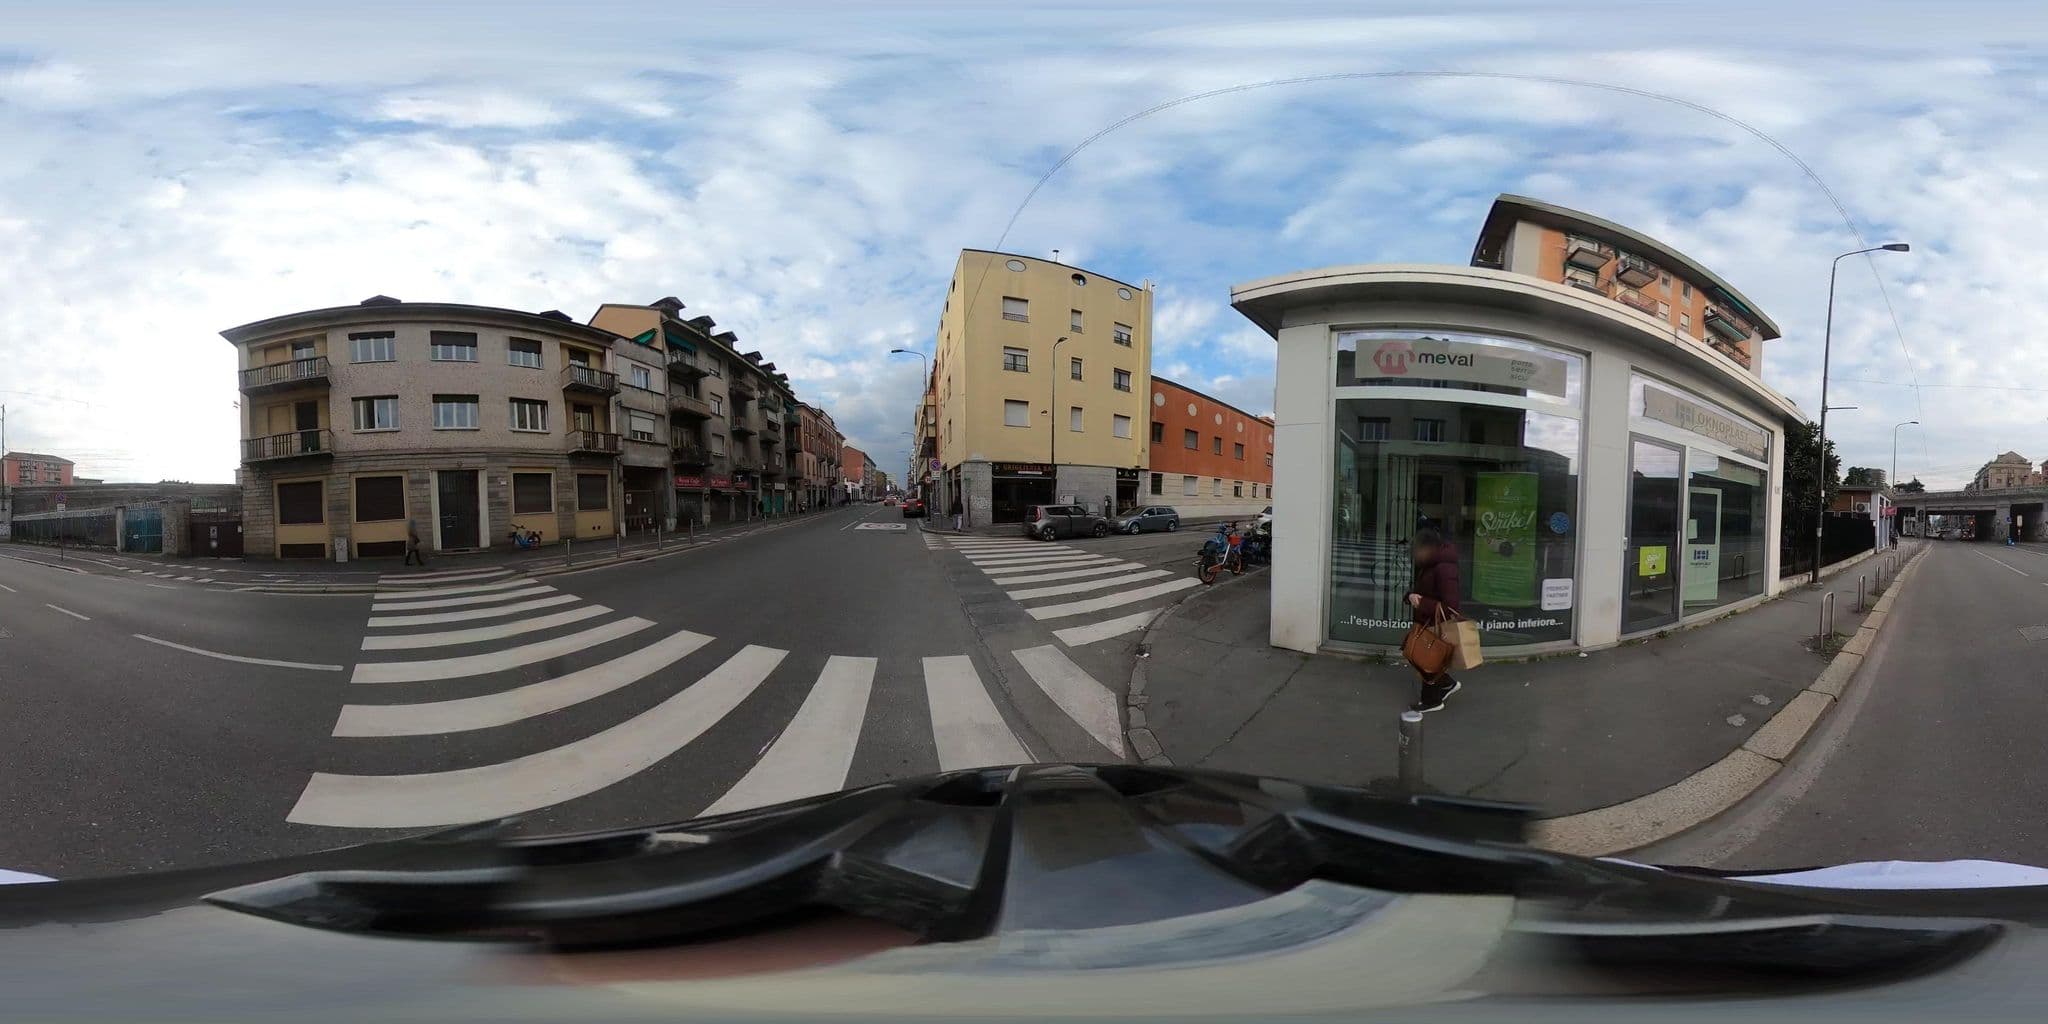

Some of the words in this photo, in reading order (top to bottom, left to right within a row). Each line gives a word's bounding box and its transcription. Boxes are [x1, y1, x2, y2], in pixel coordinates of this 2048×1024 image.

[1418, 352, 1474, 367] meval
[1697, 413, 1749, 442] OKNOPLAST
[1476, 510, 1536, 537] Strike!
[1486, 620, 1515, 632] piano
